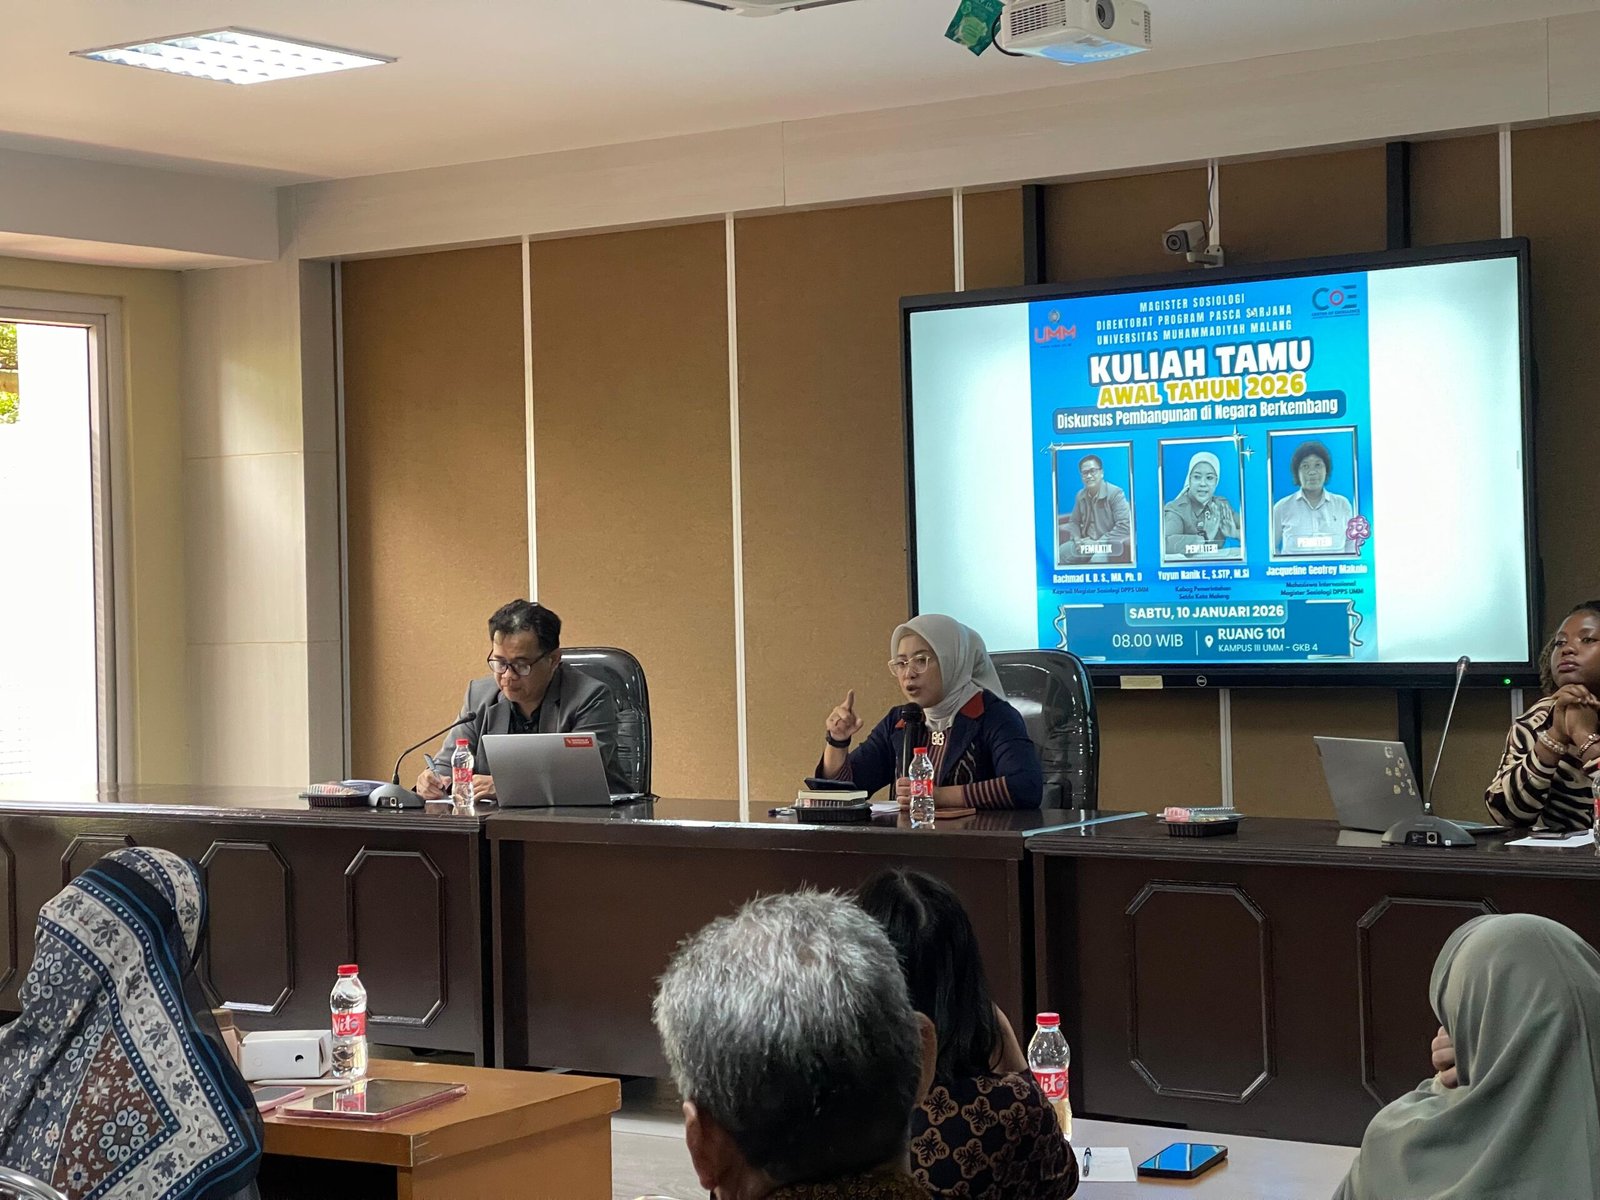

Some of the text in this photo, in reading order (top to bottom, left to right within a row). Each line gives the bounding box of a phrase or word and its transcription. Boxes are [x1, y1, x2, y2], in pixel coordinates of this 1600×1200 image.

[1139, 293, 1245, 313] MAGISTER SOSIOLOGI
[1096, 304, 1292, 331] DIREKTORAT PROGRAM PASCA SARJANA
[1034, 324, 1077, 344] UMM
[1097, 320, 1292, 346] UNIVERSITAS MUHAMMADIYAH MALANG
[1089, 339, 1311, 384] KULIAH TAMU
[1098, 373, 1305, 407] AWAL TAHUN 2026
[1057, 398, 1338, 429] Diskursus Pembangunan di Negara Berkembang
[1137, 572, 1143, 582] D
[1158, 570, 1179, 582] Yuyun
[1266, 565, 1307, 577] Jacqueline
[1129, 604, 1285, 620] SABTU, 10 JANUARI 2026
[1112, 633, 1184, 648] 08.00 WIB
[1217, 627, 1286, 640] RUANG 101
[1218, 643, 1253, 653] KAMPUS
[1253, 643, 1261, 652] III
[1262, 643, 1284, 652] UMM
[1292, 643, 1311, 652] GKB
[1312, 643, 1319, 652] 4
